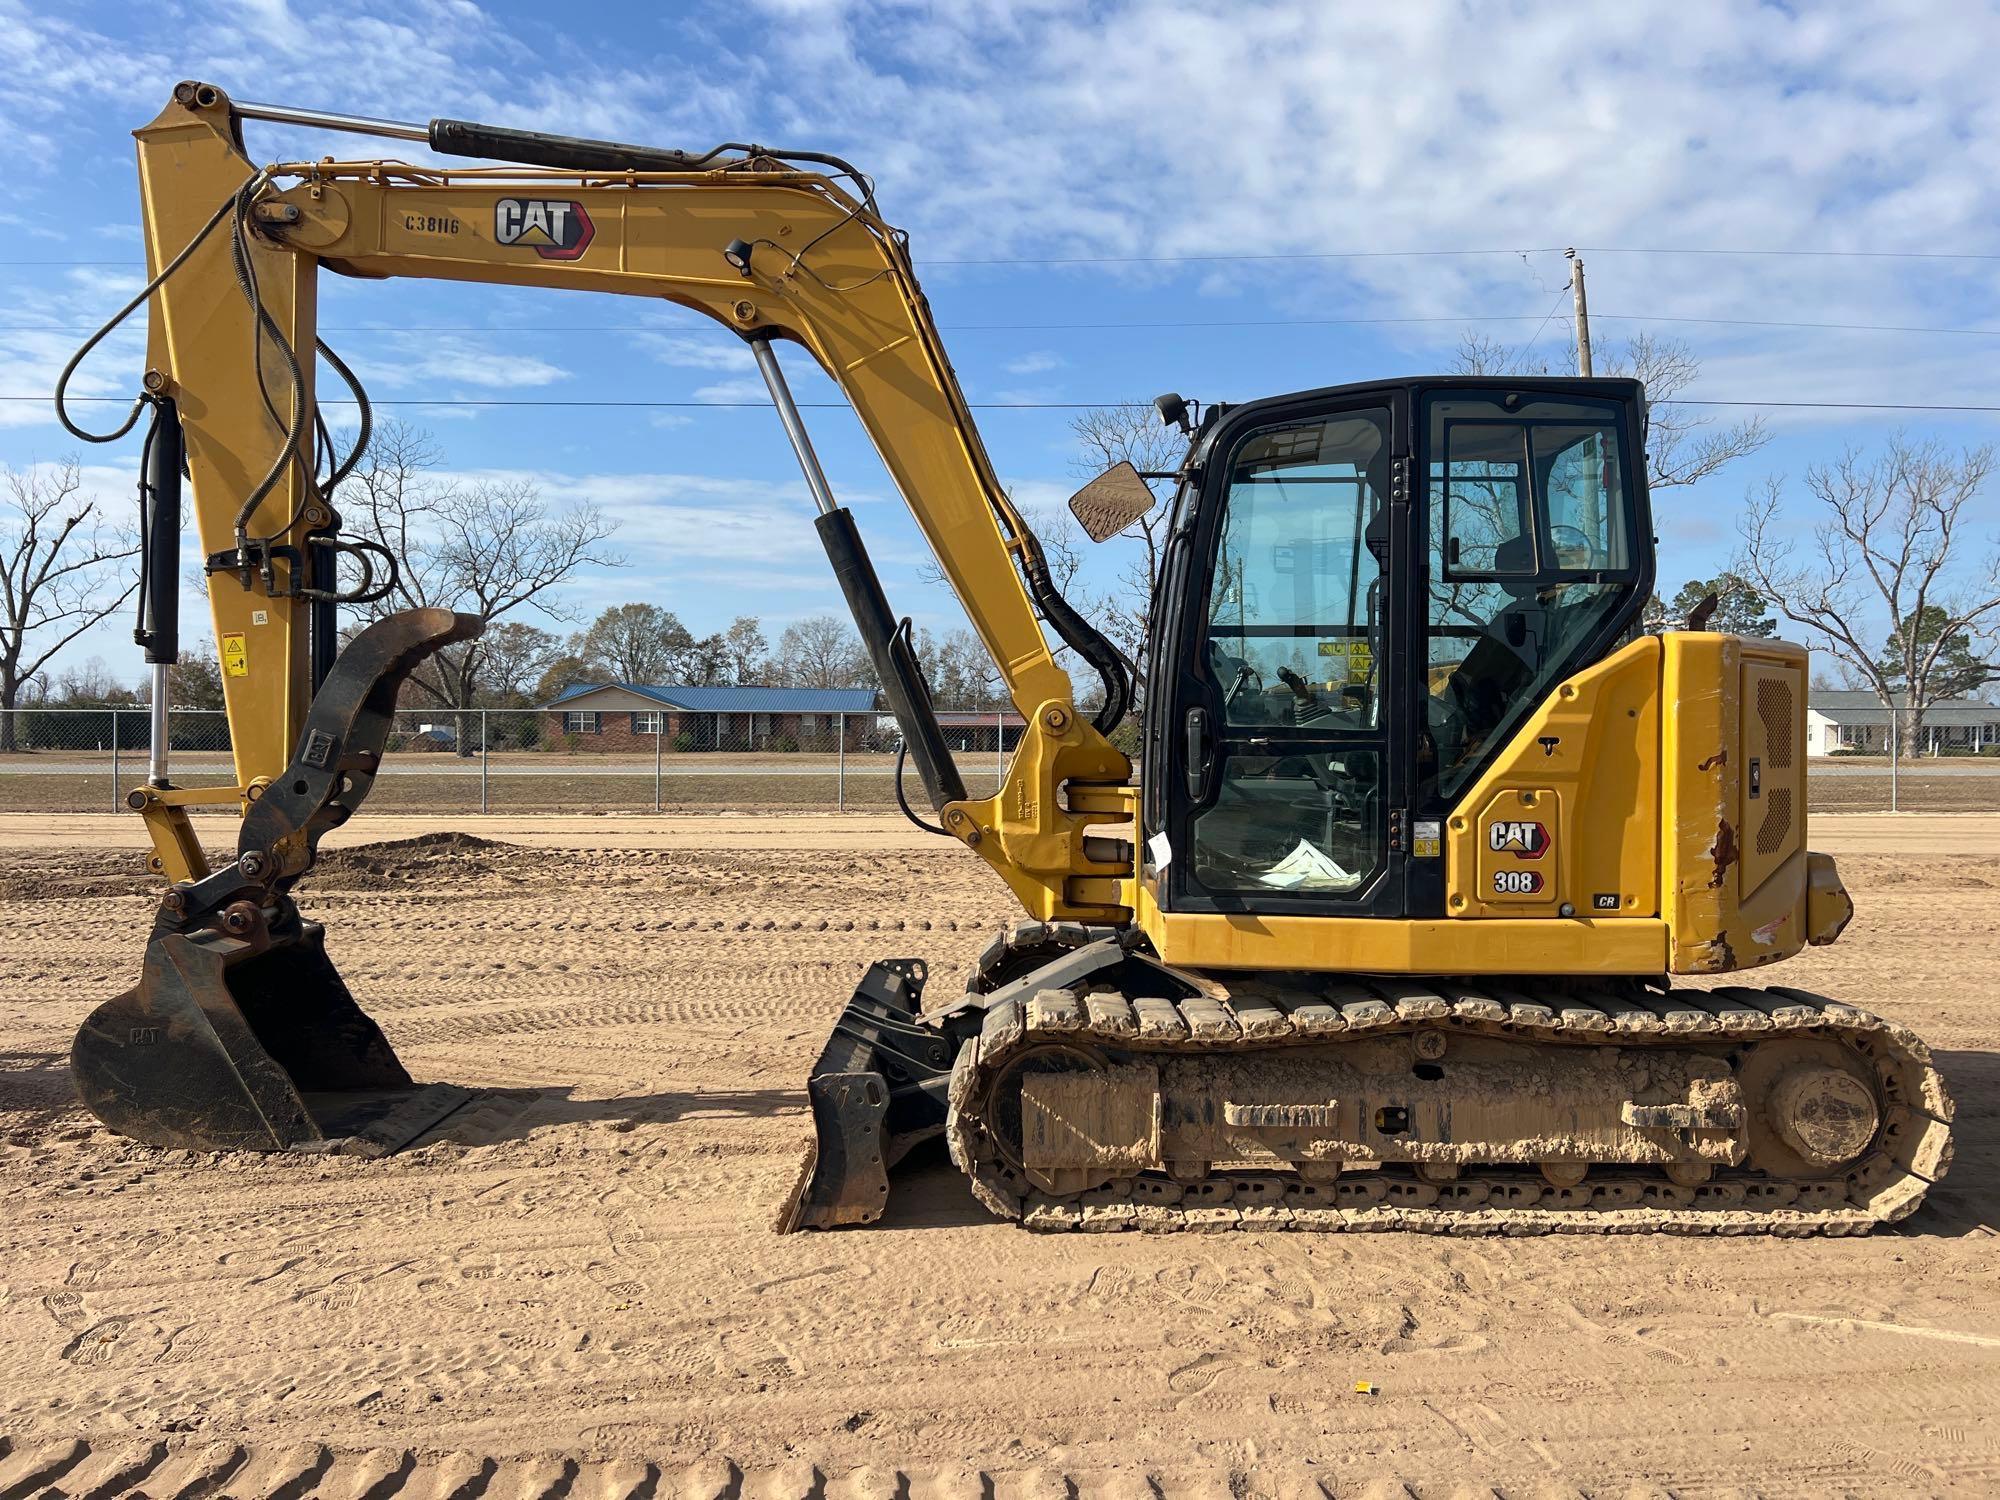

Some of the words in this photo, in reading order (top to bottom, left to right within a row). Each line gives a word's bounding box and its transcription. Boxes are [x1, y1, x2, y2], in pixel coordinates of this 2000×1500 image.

[496, 199, 571, 245] CAT
[1490, 822, 1536, 850] CAT
[1494, 872, 1532, 892] 308
[1599, 896, 1615, 907] CR
[130, 1028, 159, 1045] CAT
